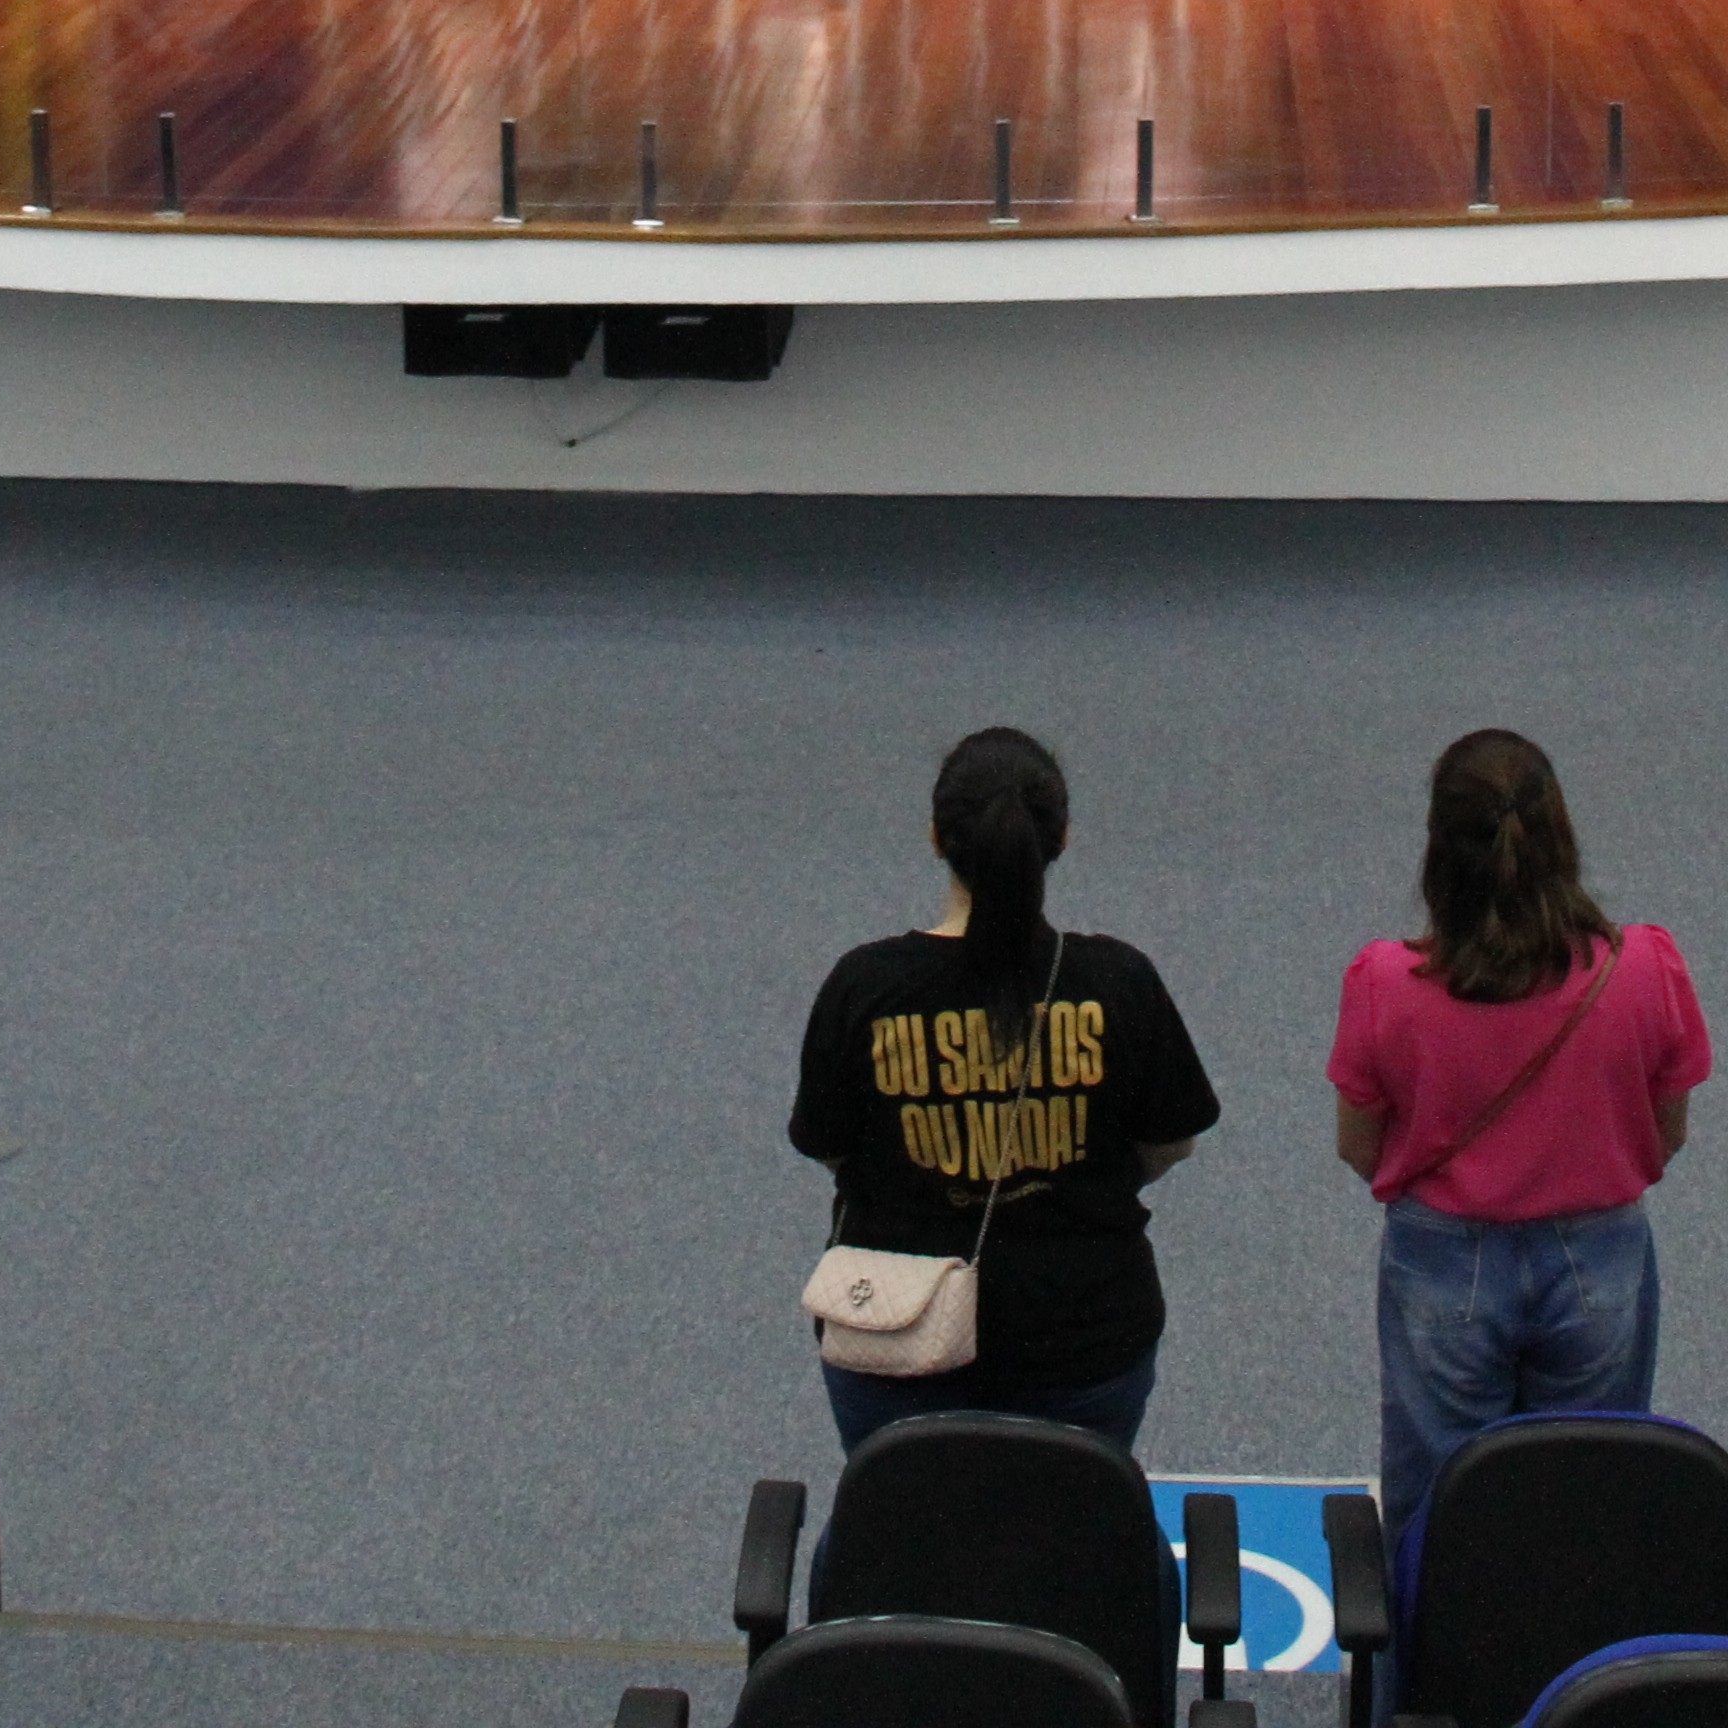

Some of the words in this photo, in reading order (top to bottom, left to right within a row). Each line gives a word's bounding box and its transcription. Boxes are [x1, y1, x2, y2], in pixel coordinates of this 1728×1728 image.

[871, 1013, 931, 1097] OU
[900, 1102, 963, 1177] OU
[963, 1094, 1088, 1182] NADA!
